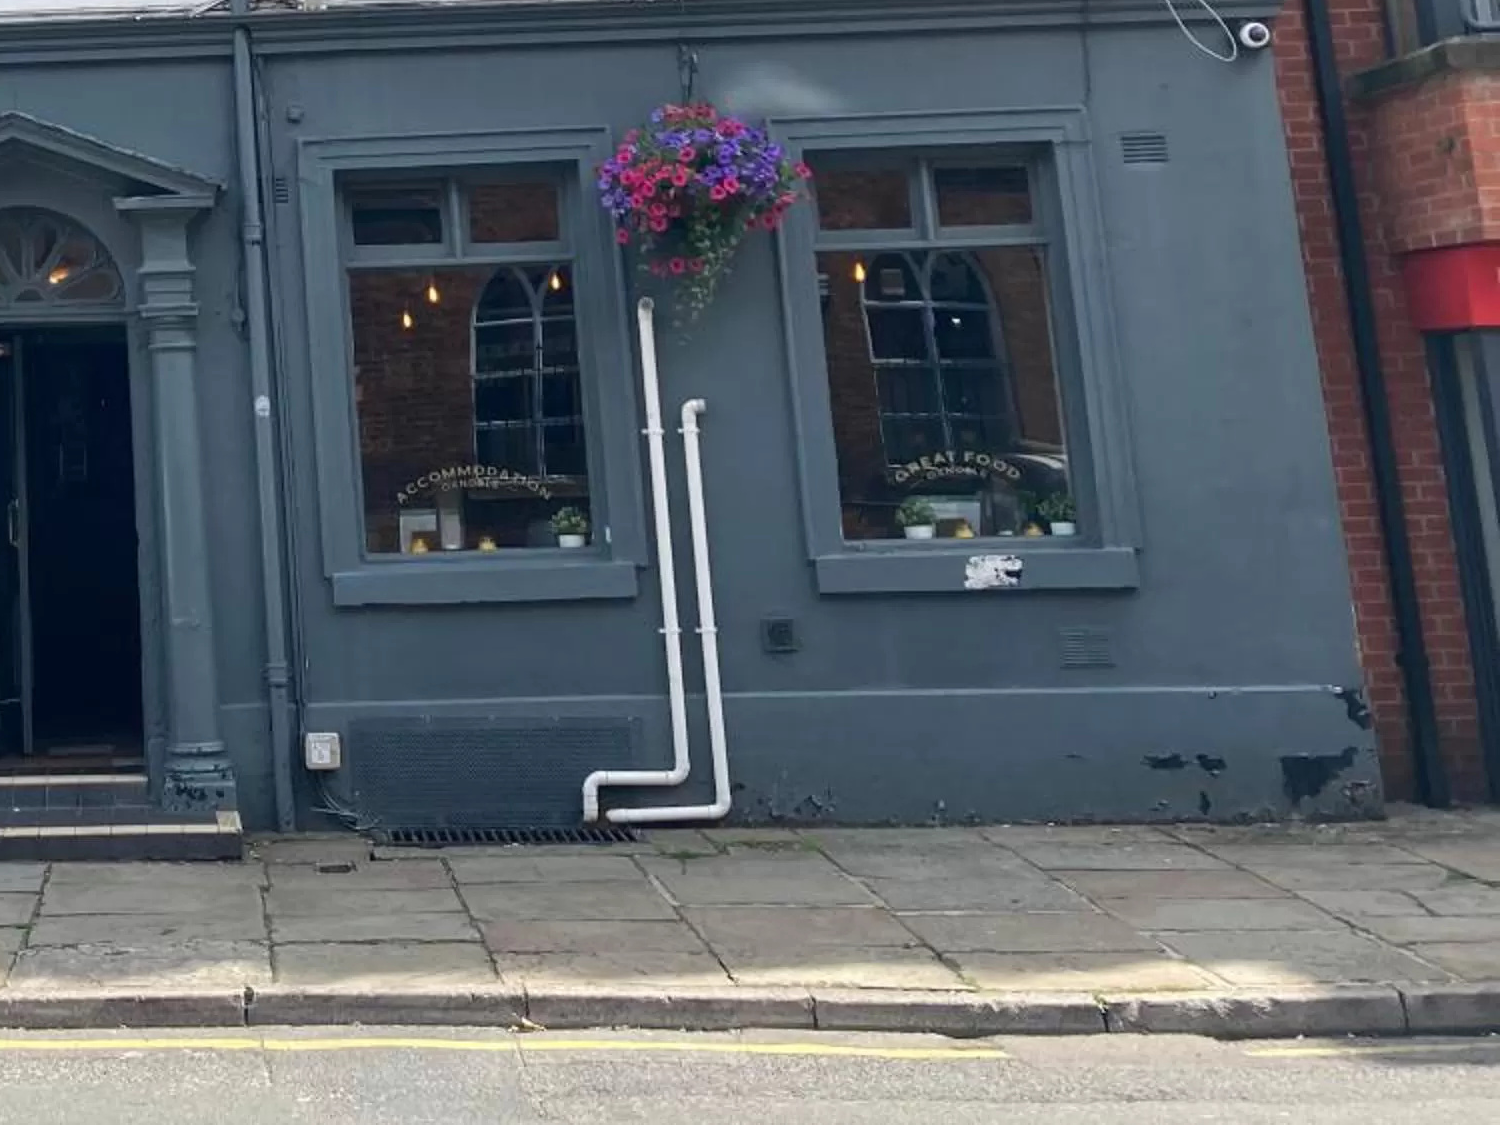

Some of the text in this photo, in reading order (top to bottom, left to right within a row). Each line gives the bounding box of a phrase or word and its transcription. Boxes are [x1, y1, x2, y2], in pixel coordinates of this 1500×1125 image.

[895, 450, 1020, 482] GREAT FOOD
[397, 465, 552, 505] ACCOMMODATION
